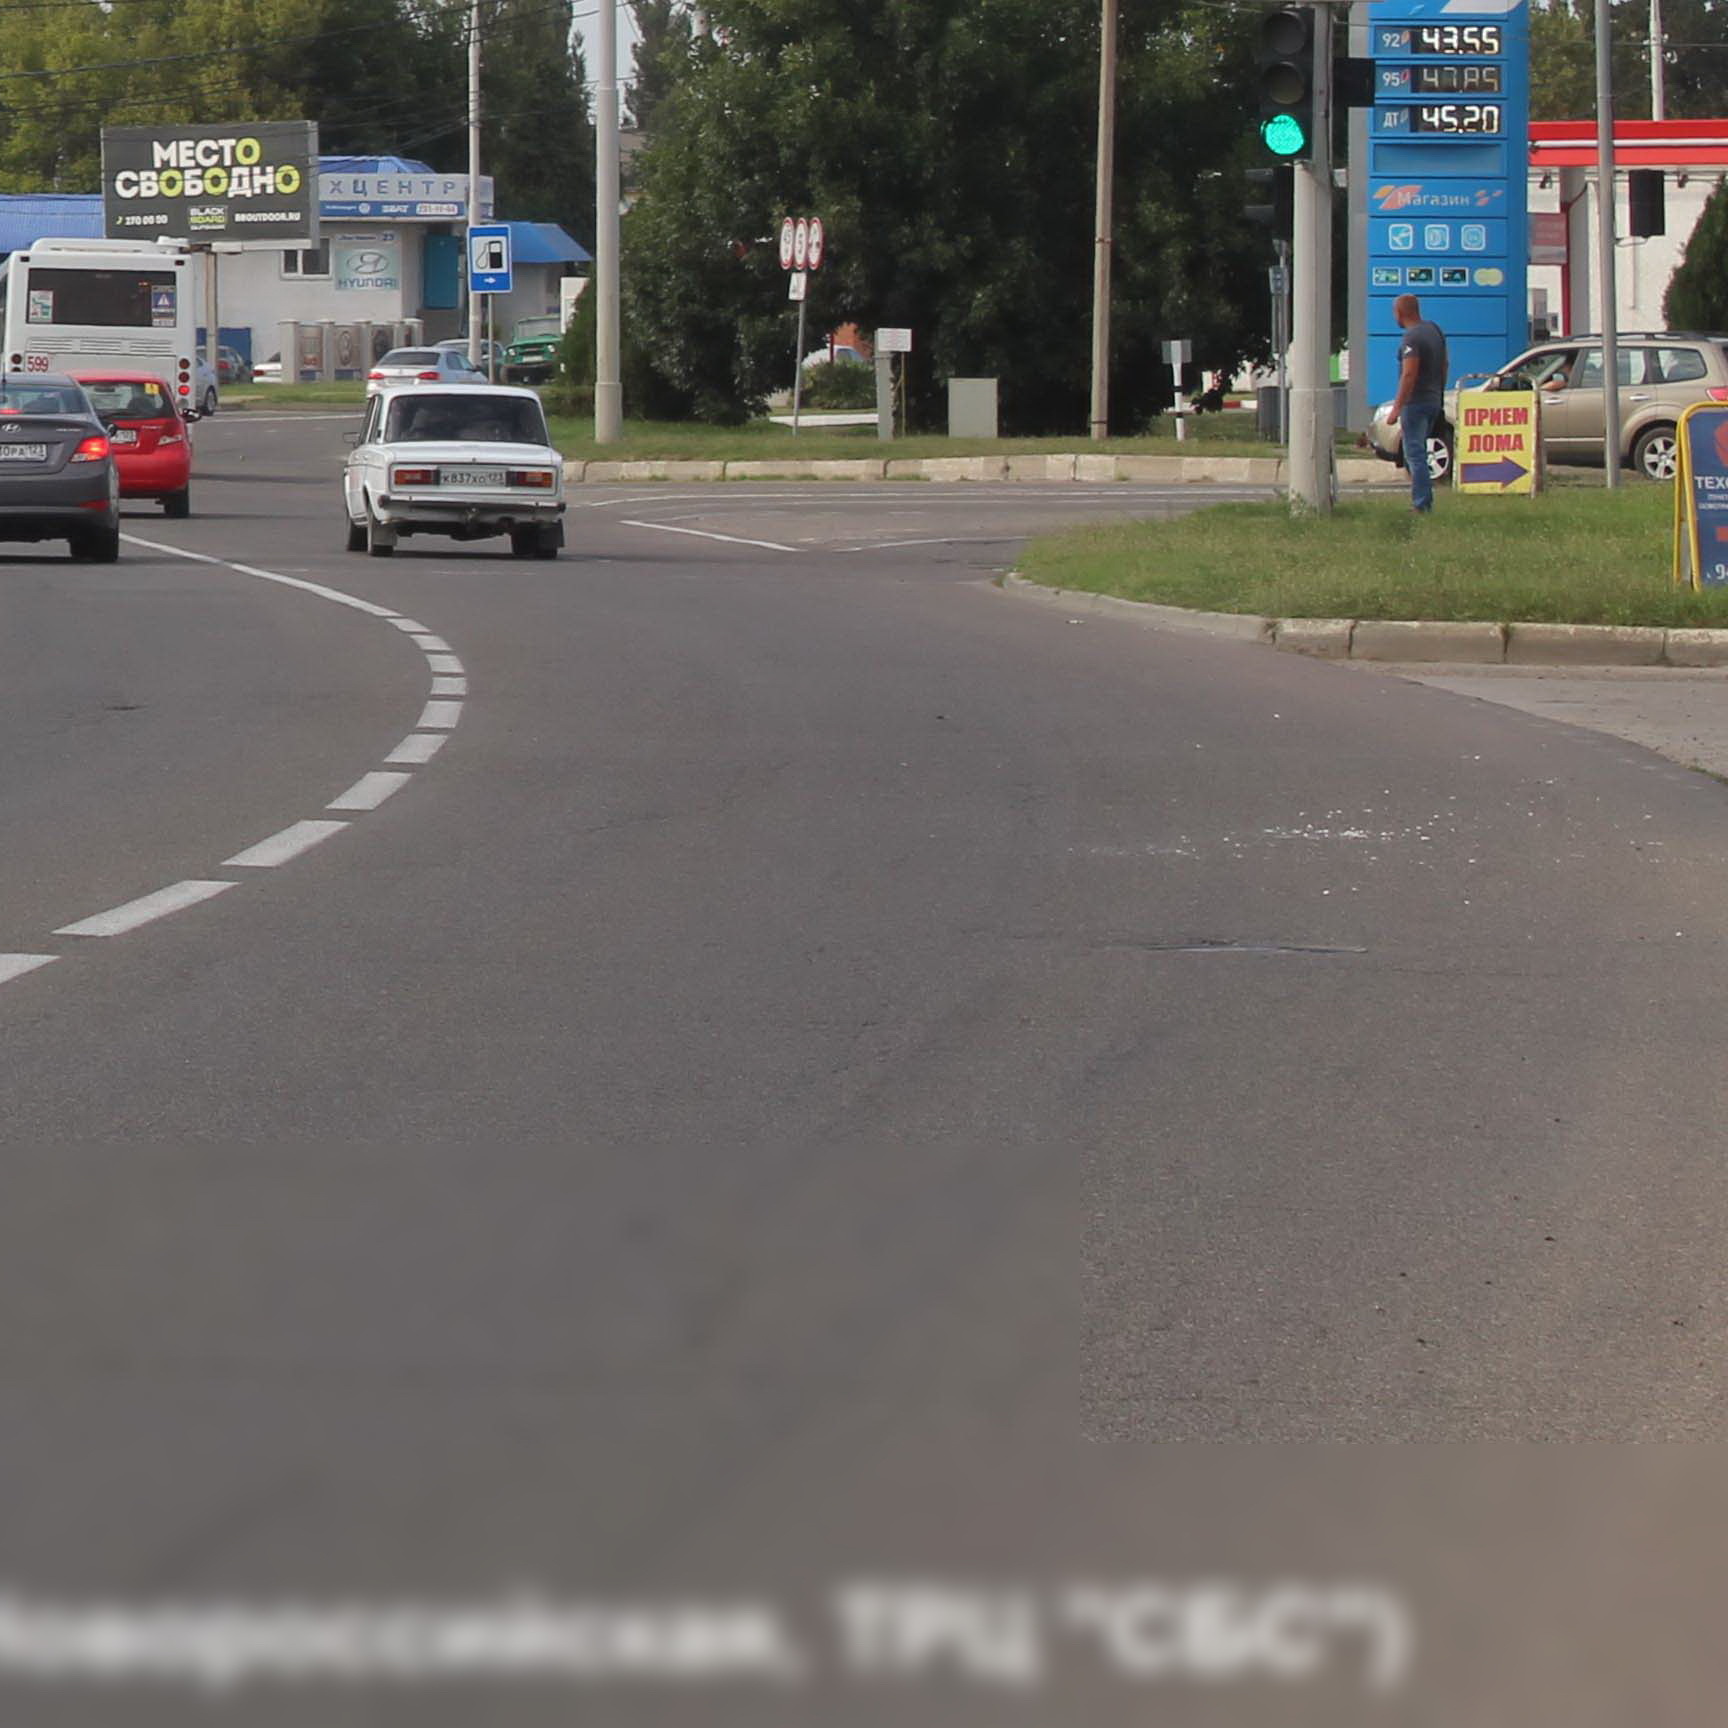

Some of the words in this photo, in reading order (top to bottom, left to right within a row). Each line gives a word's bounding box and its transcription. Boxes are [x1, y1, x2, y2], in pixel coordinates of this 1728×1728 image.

[1381, 32, 1400, 49] 92
[1381, 72, 1400, 88] 95
[1383, 113, 1400, 129] ДТ
[152, 137, 261, 169] МЕСТО
[114, 165, 301, 199] СВОБОДНО
[1398, 190, 1471, 208] Магазин
[189, 207, 225, 216] BLACK
[337, 277, 398, 288] HYUNDAI
[26, 355, 49, 372] 599
[1463, 407, 1529, 427] ПРИЕМ
[1467, 433, 1525, 453] ЛОМА
